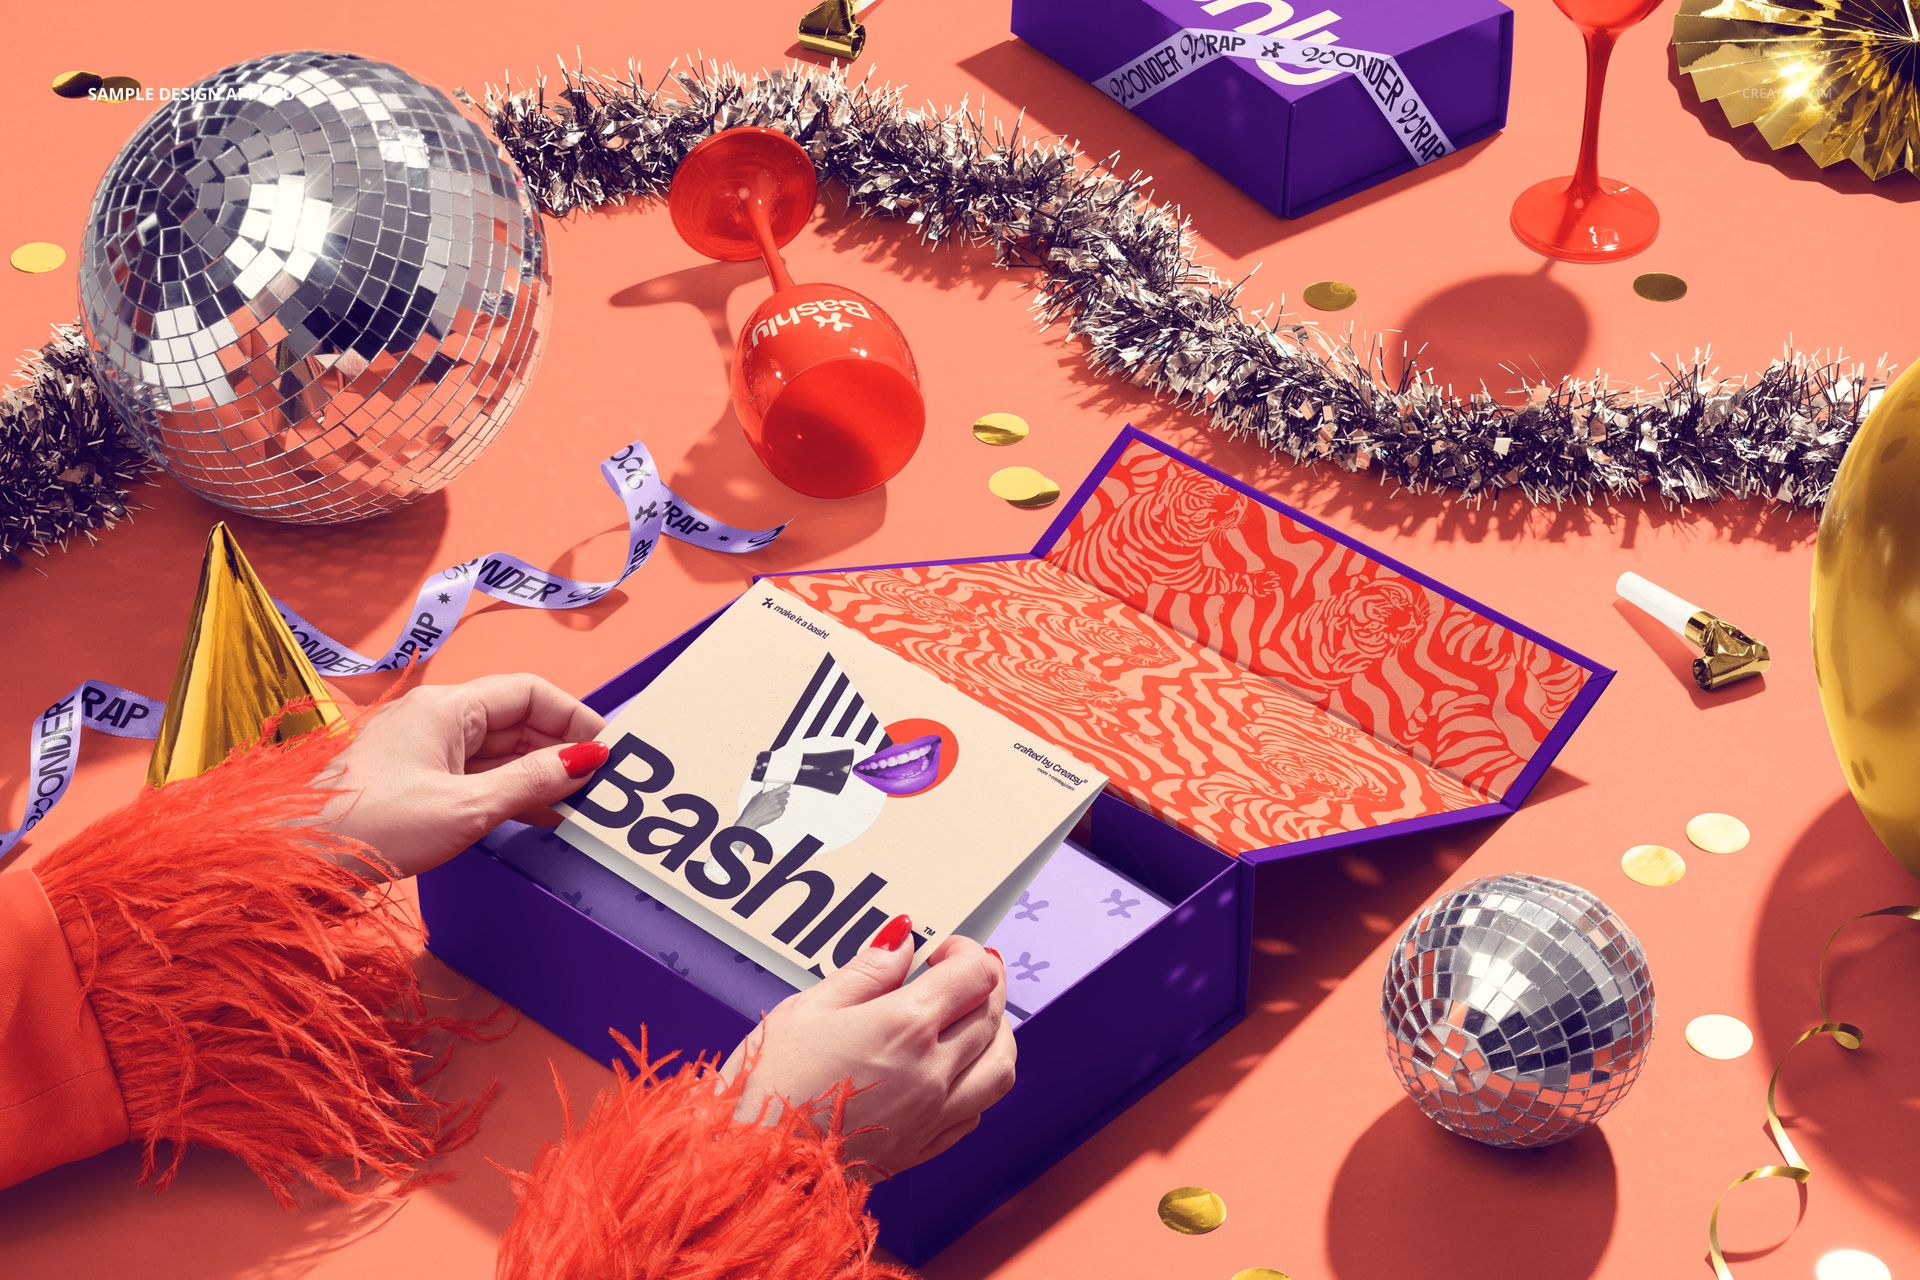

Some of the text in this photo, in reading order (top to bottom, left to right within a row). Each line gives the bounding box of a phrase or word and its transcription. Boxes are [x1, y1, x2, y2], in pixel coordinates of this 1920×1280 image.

[1109, 33, 1446, 162] WONDER WRAP WONDER WRAP
[752, 299, 872, 347] Bashly
[281, 613, 372, 673] ONDER
[773, 605, 830, 640] make it a bash!
[26, 686, 149, 831] WONDER RAP
[1013, 742, 1044, 762] crafted
[1041, 757, 1054, 769] by
